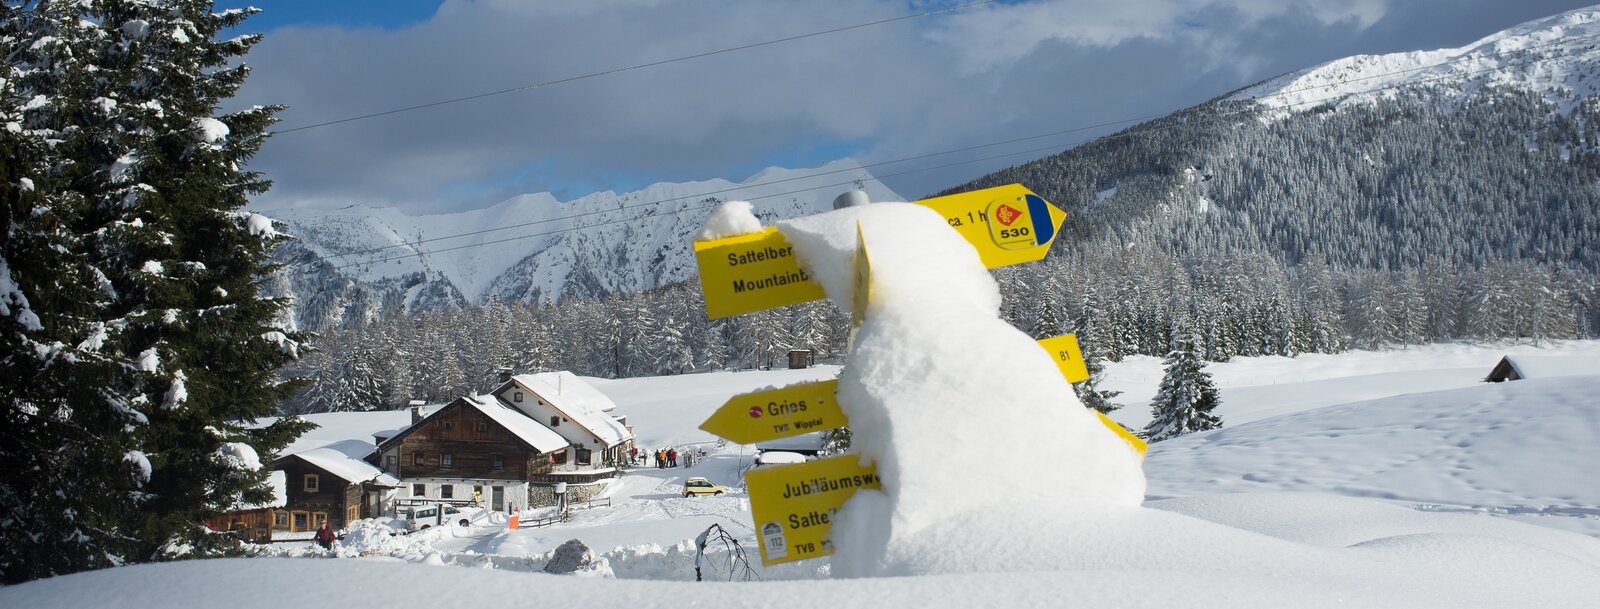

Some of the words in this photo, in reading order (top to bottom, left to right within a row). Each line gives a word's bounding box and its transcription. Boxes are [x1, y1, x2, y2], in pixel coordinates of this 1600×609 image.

[967, 211, 974, 224] 1
[978, 209, 987, 222] h
[1000, 227, 1029, 239] 530
[727, 245, 793, 267] Sattelber
[732, 269, 809, 293] Mountainb
[1059, 350, 1070, 361] 81
[767, 400, 807, 416] Gries
[794, 417, 823, 430] Wipptal
[788, 507, 836, 529] Satte
[794, 542, 816, 554] TVB
